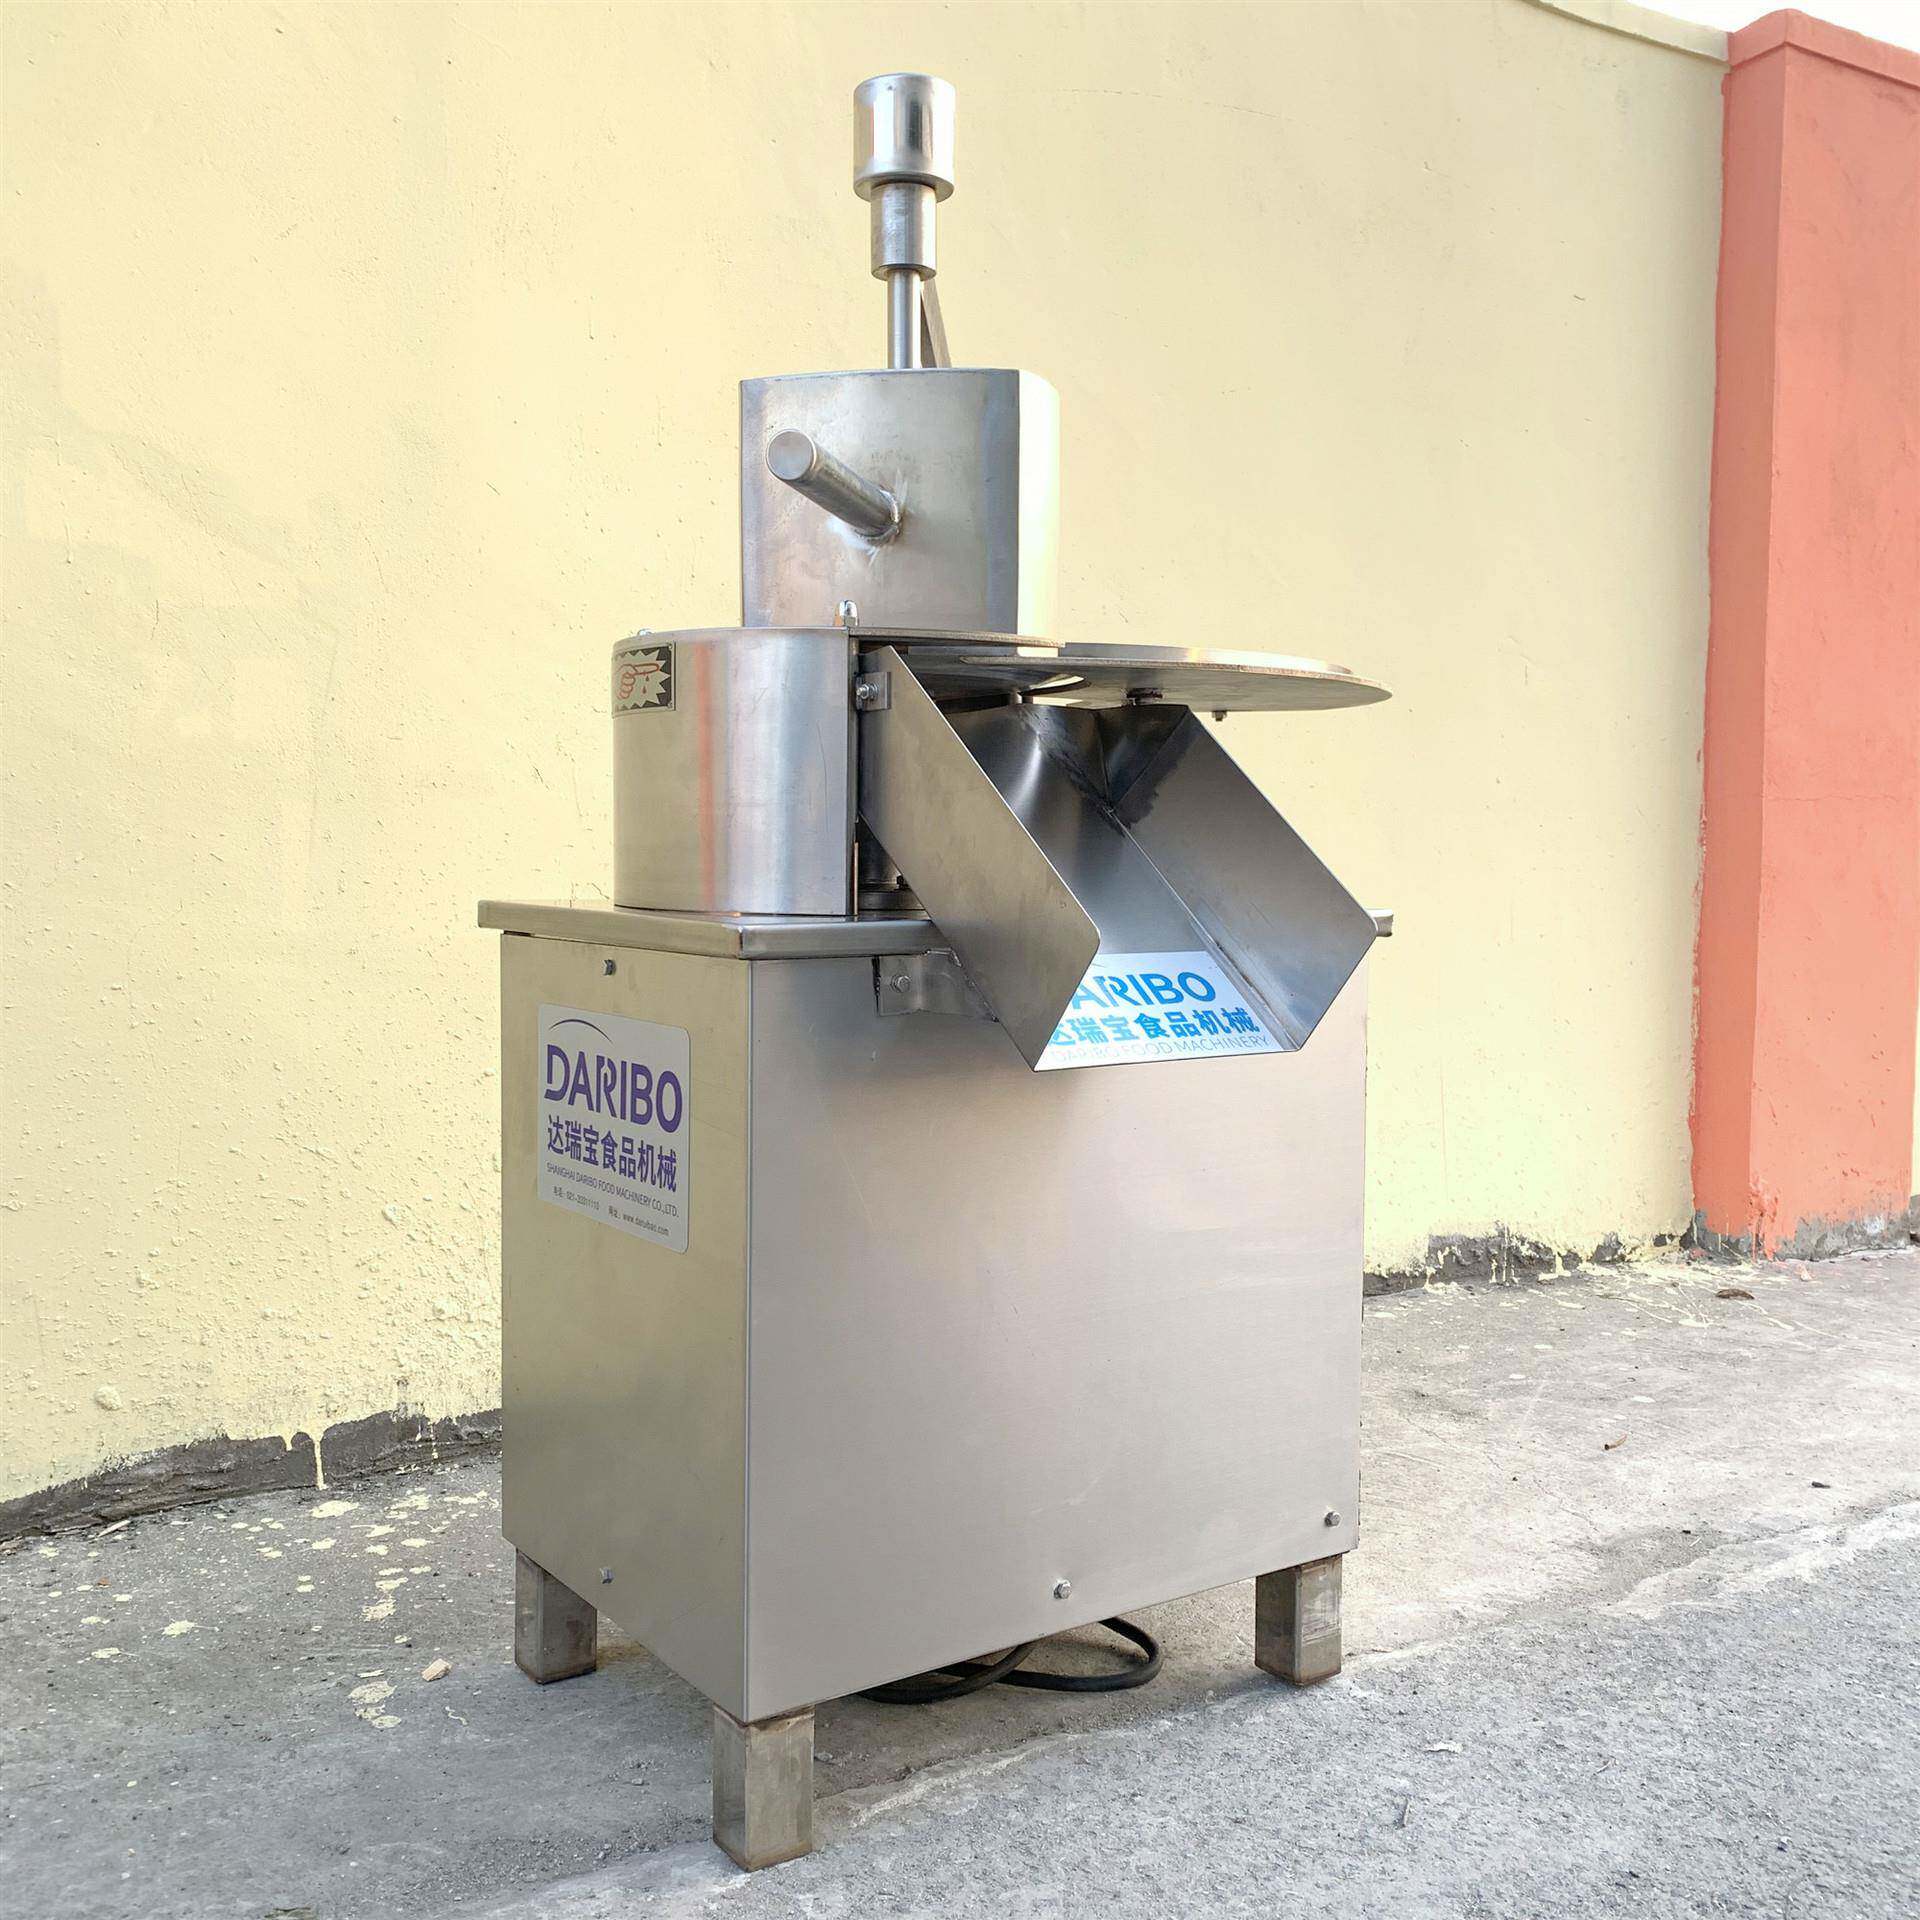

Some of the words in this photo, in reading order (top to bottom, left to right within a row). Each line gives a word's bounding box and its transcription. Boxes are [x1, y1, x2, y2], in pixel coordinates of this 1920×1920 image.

[1070, 972, 1216, 1010] ARIBO
[1121, 1041, 1174, 1058] FOOD
[1176, 1035, 1270, 1054] MACHINERY
[544, 1044, 683, 1134] DARIBO
[547, 1114, 677, 1193] 达瑞宝食品机械
[546, 1161, 576, 1182] SHANGHAI
[576, 1171, 598, 1189] DARIBO
[598, 1179, 616, 1195] FOOD
[615, 1185, 651, 1209] MACHINERY
